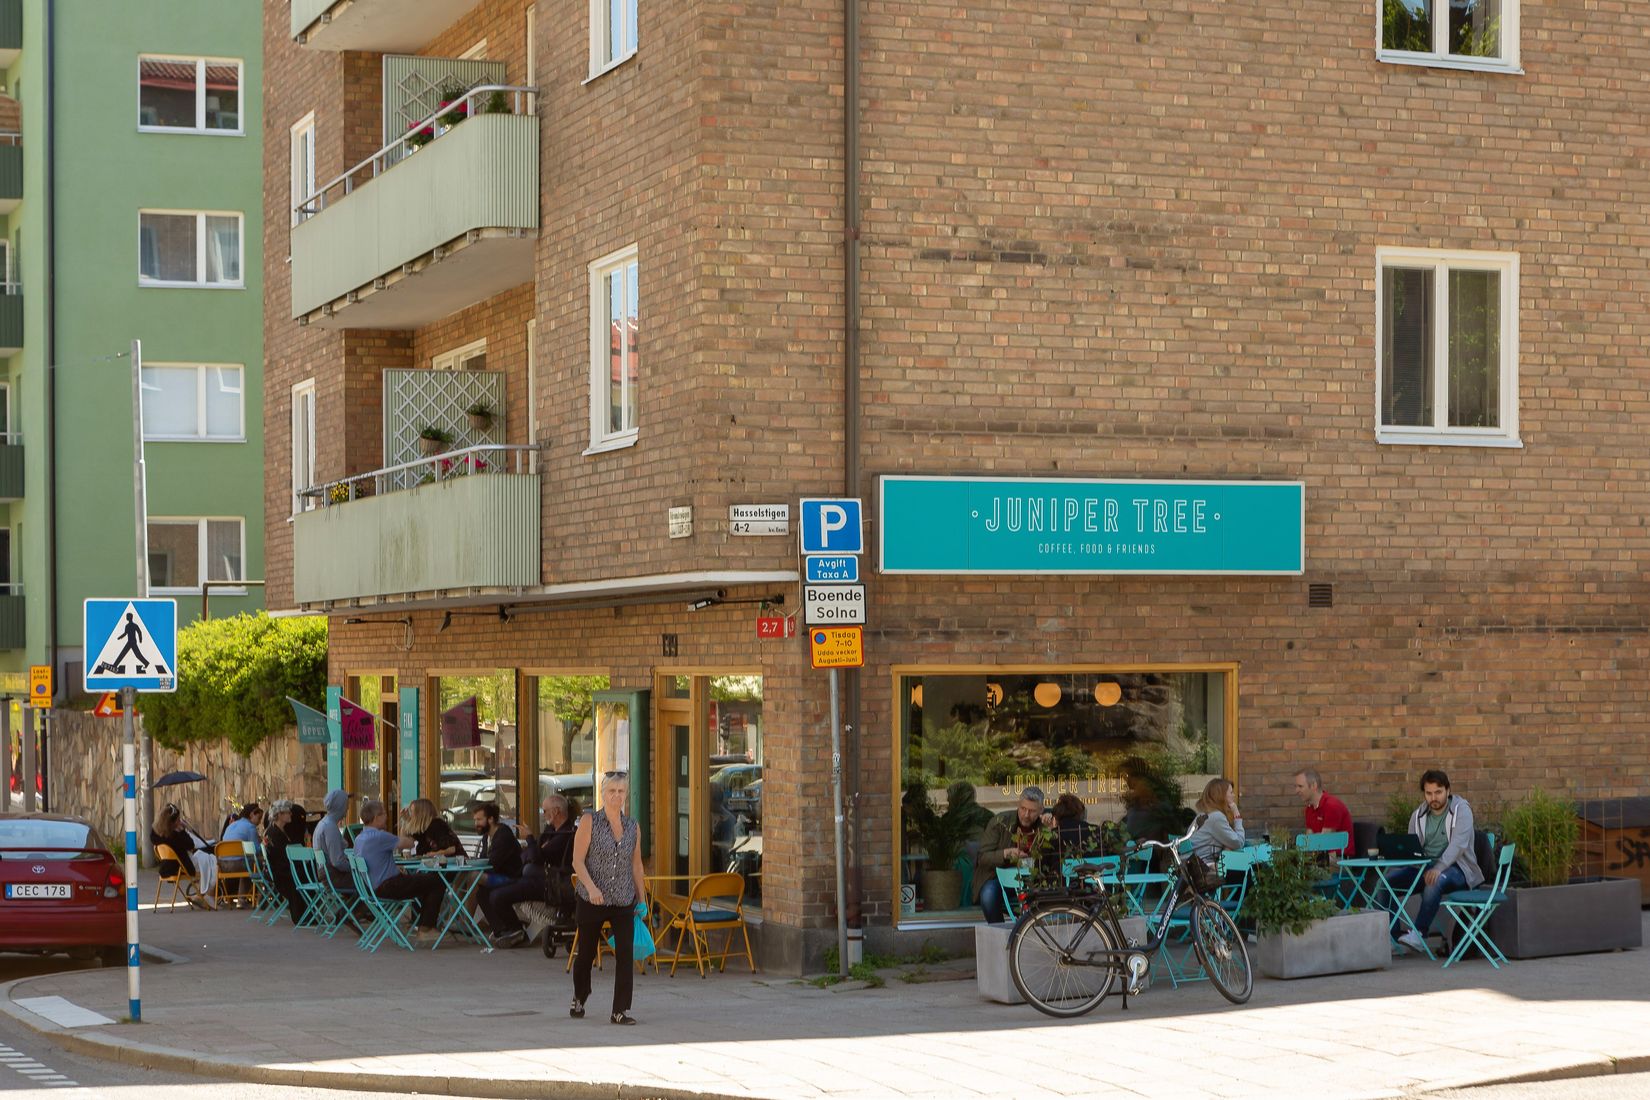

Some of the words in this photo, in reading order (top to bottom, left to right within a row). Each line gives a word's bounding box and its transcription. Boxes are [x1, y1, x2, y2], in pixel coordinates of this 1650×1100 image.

[985, 497, 1119, 532] JUNIPER
[1132, 499, 1206, 533] TREE
[733, 522, 750, 533] 4-2
[820, 504, 847, 548] P
[1038, 543, 1076, 555] COFFEE,
[1080, 543, 1103, 554] FOOD
[1107, 543, 1112, 554] &
[1116, 543, 1155, 554] FRIENDS
[818, 559, 846, 569] Avgift
[817, 570, 839, 578] Taxa
[842, 570, 849, 578] A
[807, 589, 862, 602] Boende
[817, 606, 857, 619] Solna
[762, 621, 778, 634] 2,7
[831, 631, 856, 639] Tisdag
[1002, 773, 1079, 796] JUNIPER
[16, 885, 39, 896] CEC
[44, 885, 66, 896] 178
